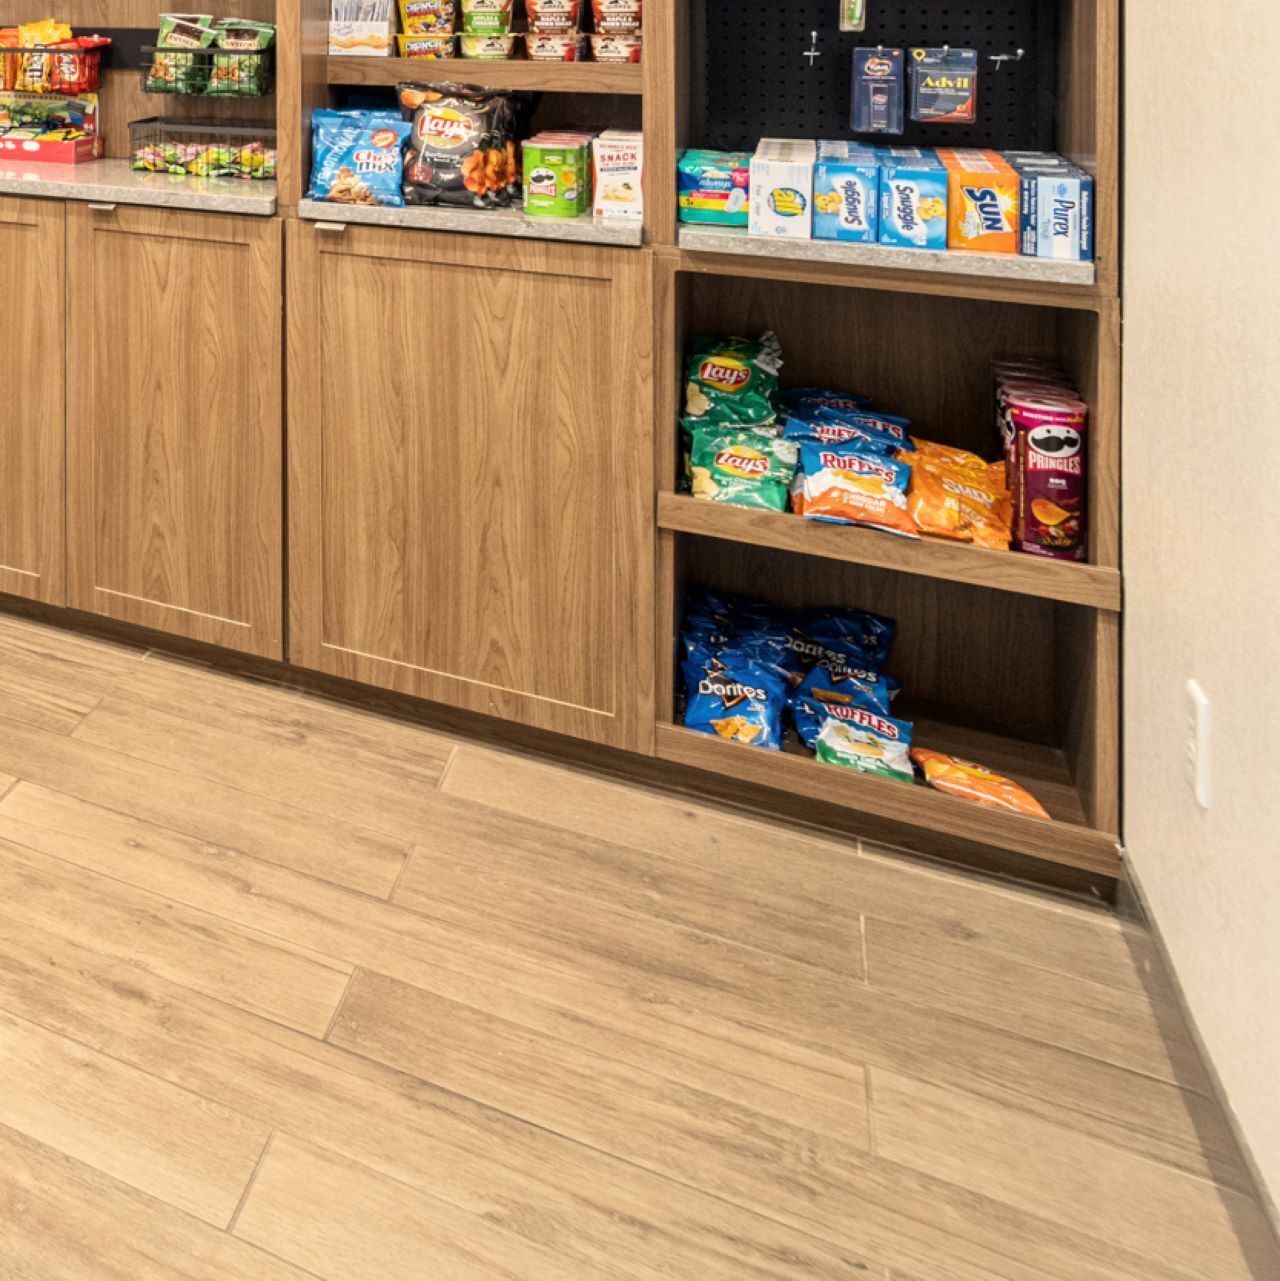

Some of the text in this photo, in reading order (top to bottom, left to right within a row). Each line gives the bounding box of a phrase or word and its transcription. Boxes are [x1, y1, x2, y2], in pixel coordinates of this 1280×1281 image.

[922, 76, 969, 89] Advil
[600, 153, 637, 162] SNACK
[841, 180, 862, 225] Snuggle
[896, 185, 918, 231] Snuggle
[964, 186, 1004, 231] SUN
[1053, 198, 1075, 238] Purex
[1028, 449, 1080, 474] PRINGLES
[698, 679, 767, 700] Doritos
[825, 703, 898, 739] RUFFLES
